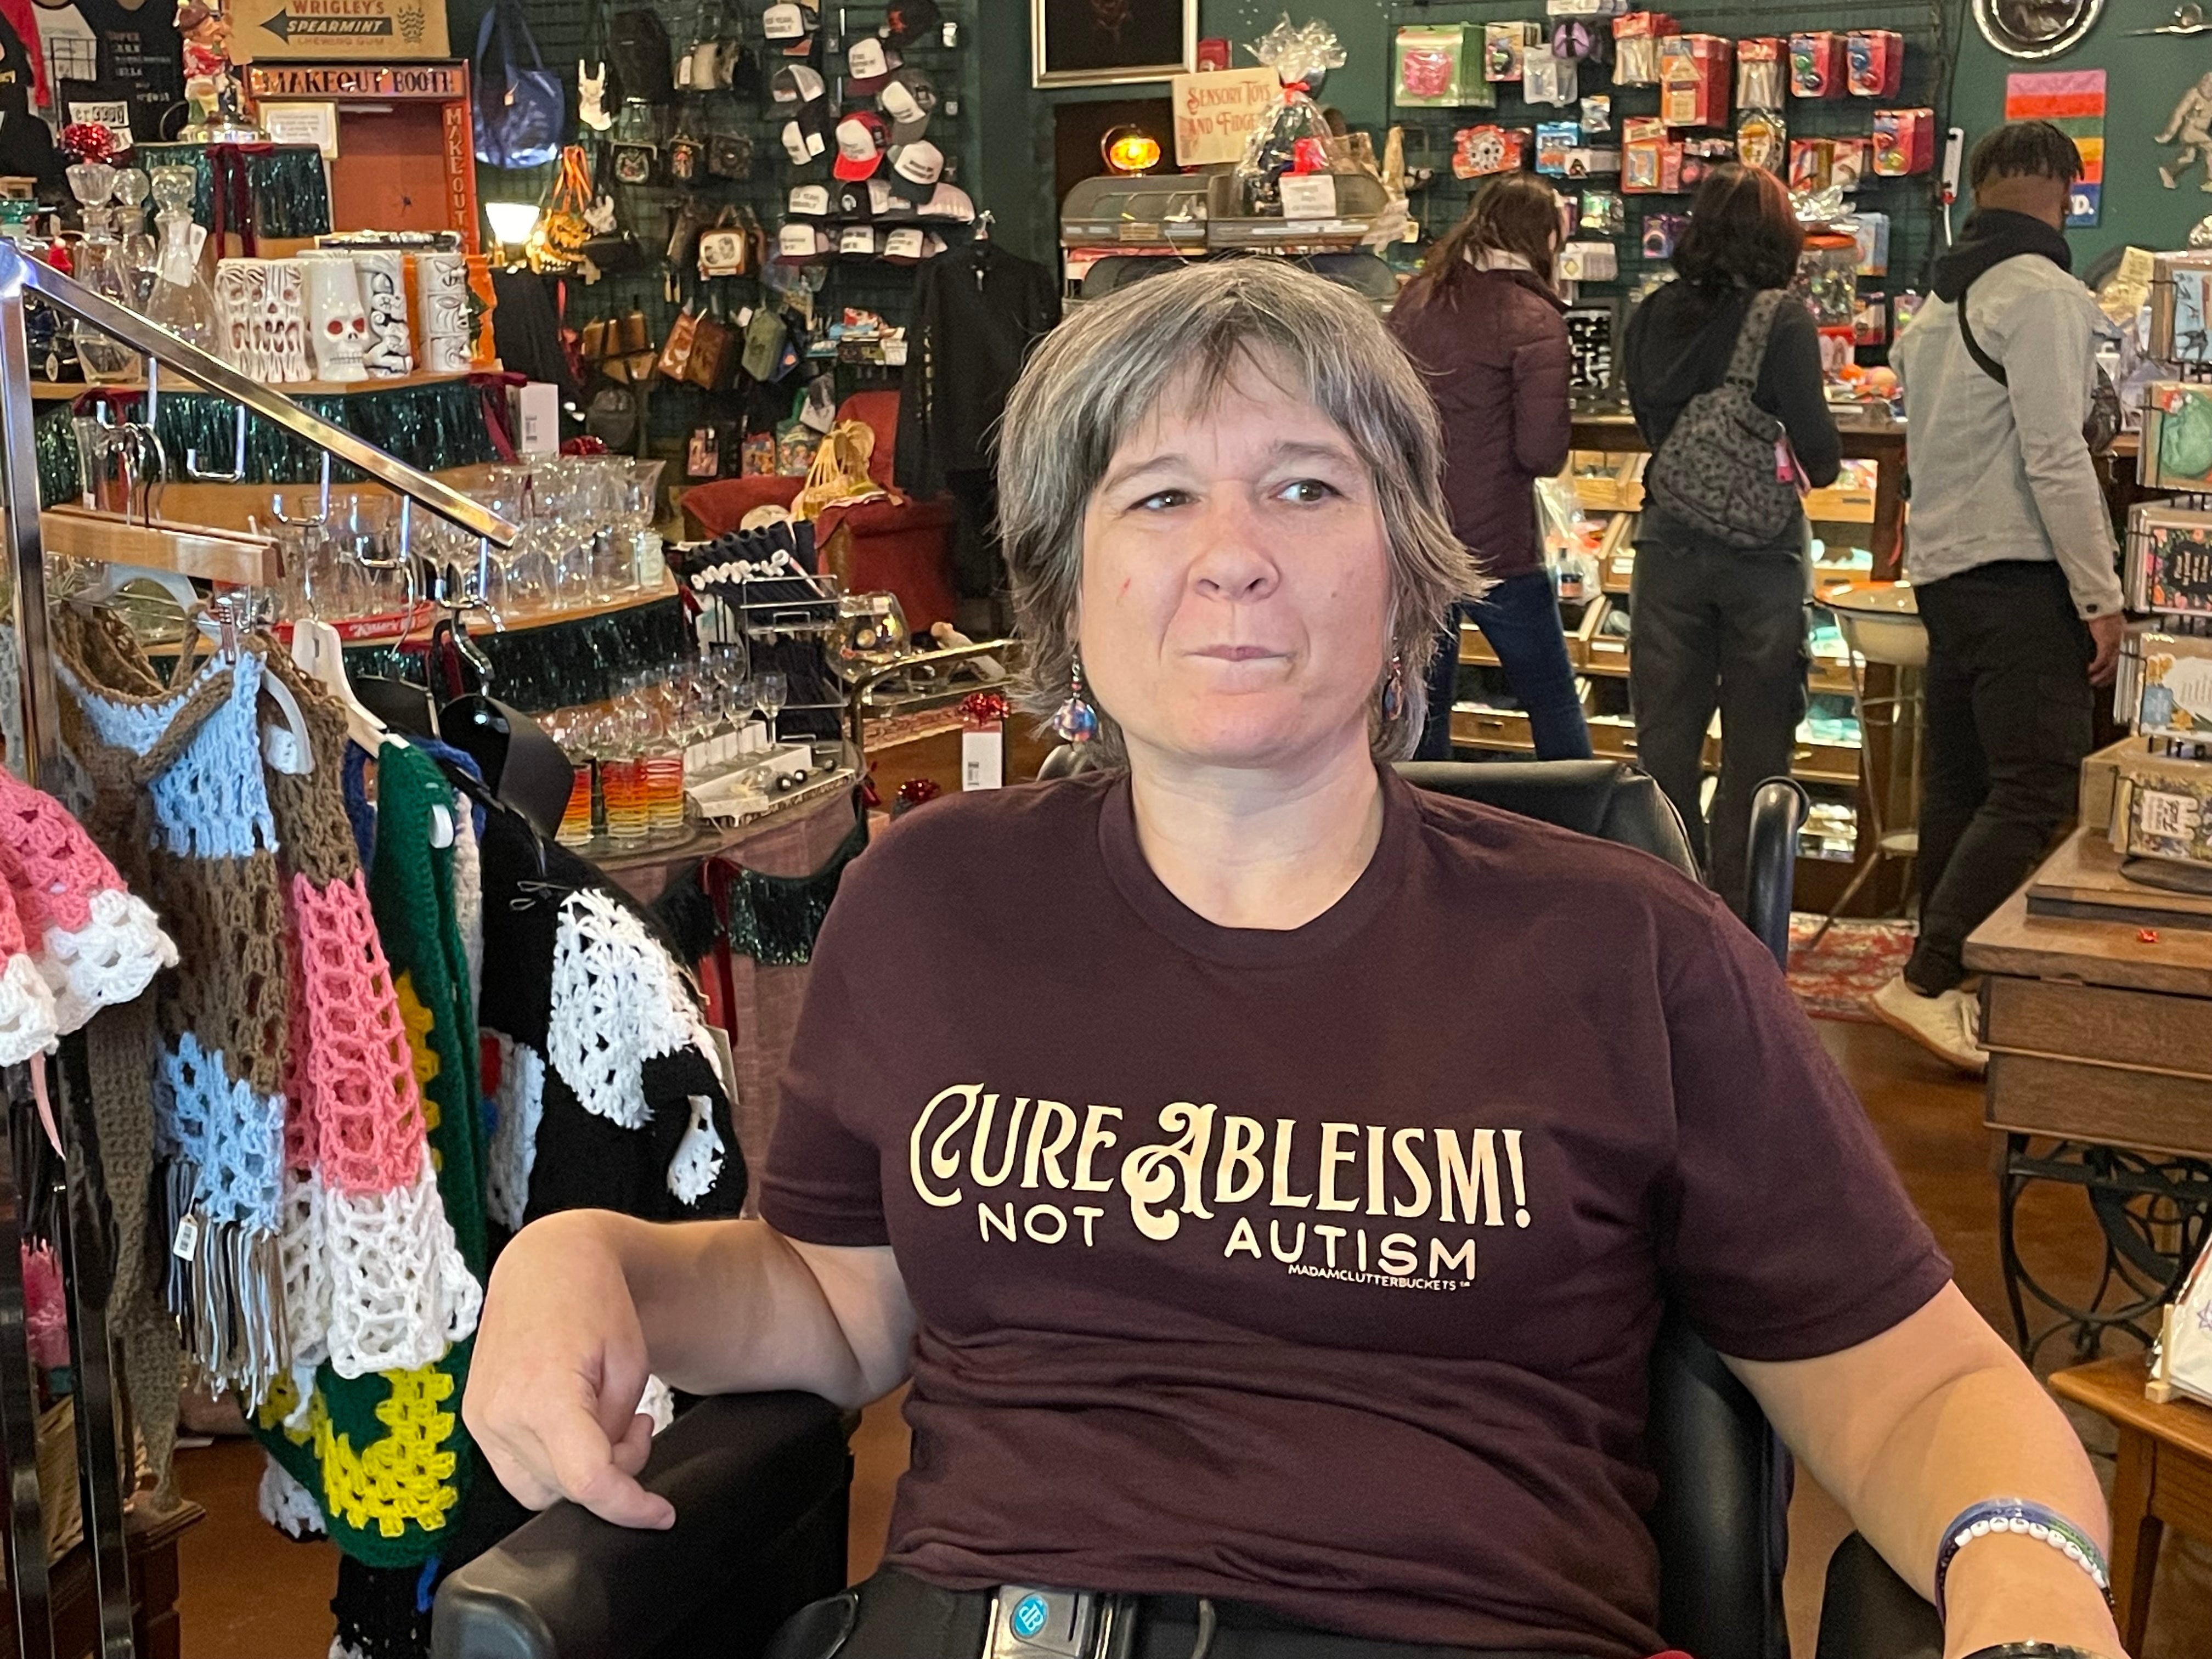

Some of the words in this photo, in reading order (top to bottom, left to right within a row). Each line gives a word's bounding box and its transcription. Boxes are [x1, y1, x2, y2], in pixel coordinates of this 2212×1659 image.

[293, 0, 385, 14] WRIGLEY'S
[286, 20, 383, 33] SPEARMINT
[357, 37, 384, 46] GUM
[262, 71, 384, 93] MAKEOUT
[393, 71, 453, 93] BOOTH
[1187, 87, 1242, 115] SENSORY
[1243, 81, 1270, 105] TOYS
[1188, 116, 1213, 136] AND
[445, 108, 467, 226] MAKEOUT
[910, 1082, 1123, 1207] CURE
[1120, 1102, 1531, 1241] ABLEISM!
[978, 1201, 1104, 1247] NOT
[1223, 1216, 1476, 1280] AUTISM
[1288, 1264, 1457, 1290] MADAMCLUTTERBUCKETS
